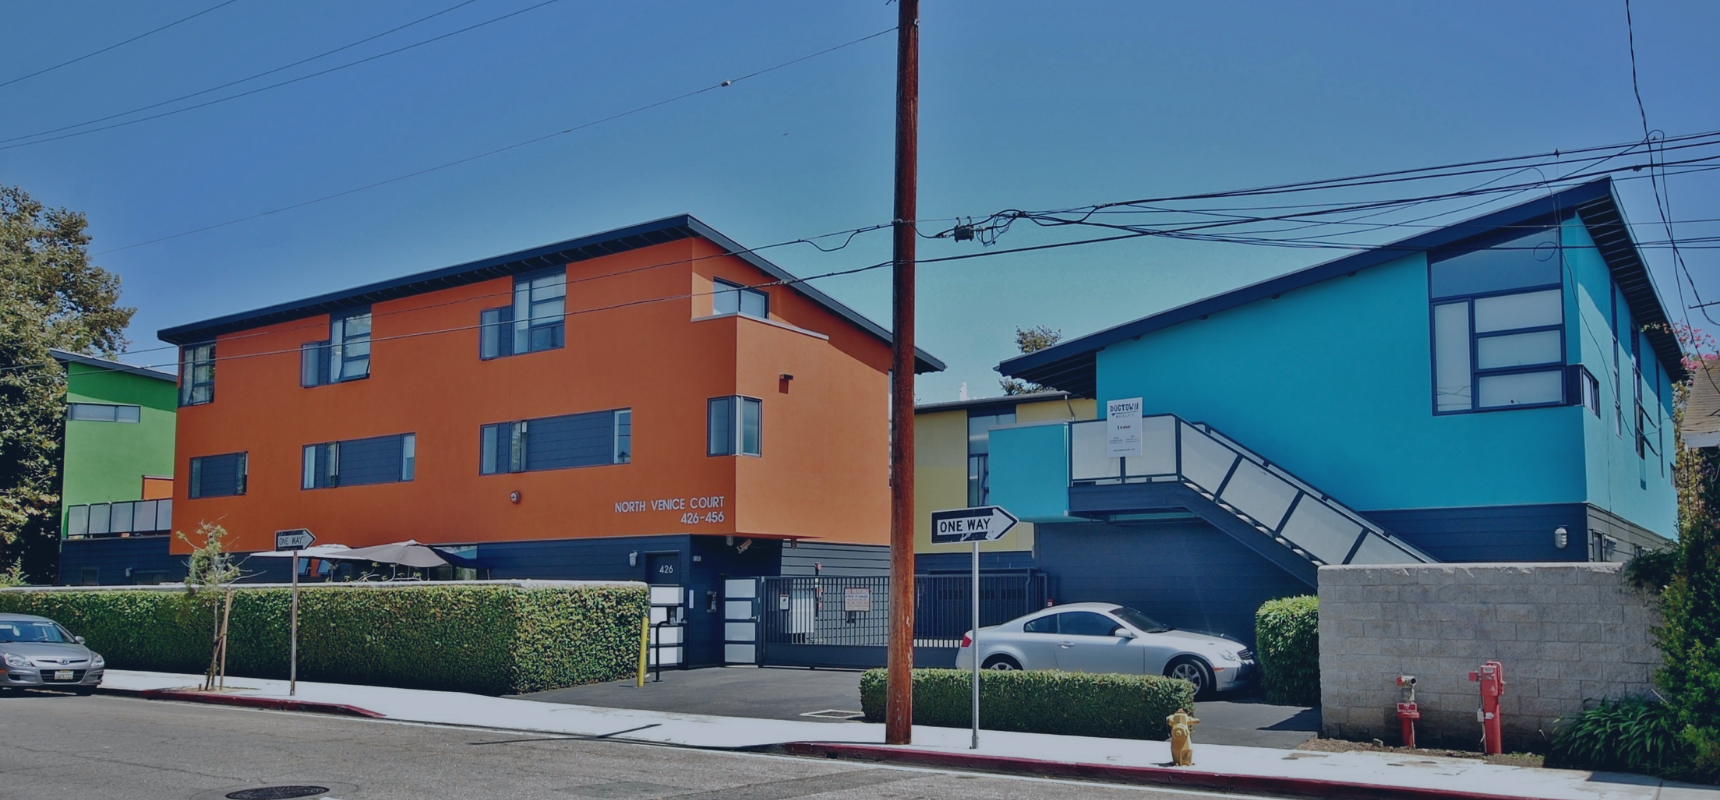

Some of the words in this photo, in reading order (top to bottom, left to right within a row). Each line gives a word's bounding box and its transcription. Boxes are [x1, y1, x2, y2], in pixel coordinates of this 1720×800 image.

[614, 501, 646, 513] NORTH
[651, 498, 685, 511] VENICE
[690, 496, 725, 509] COURT
[681, 511, 725, 524] 426-456
[940, 520, 963, 533] ONE
[967, 518, 991, 531] WAY
[279, 537, 289, 546] ONE
[291, 535, 304, 545] WAY
[659, 564, 674, 574] 426
